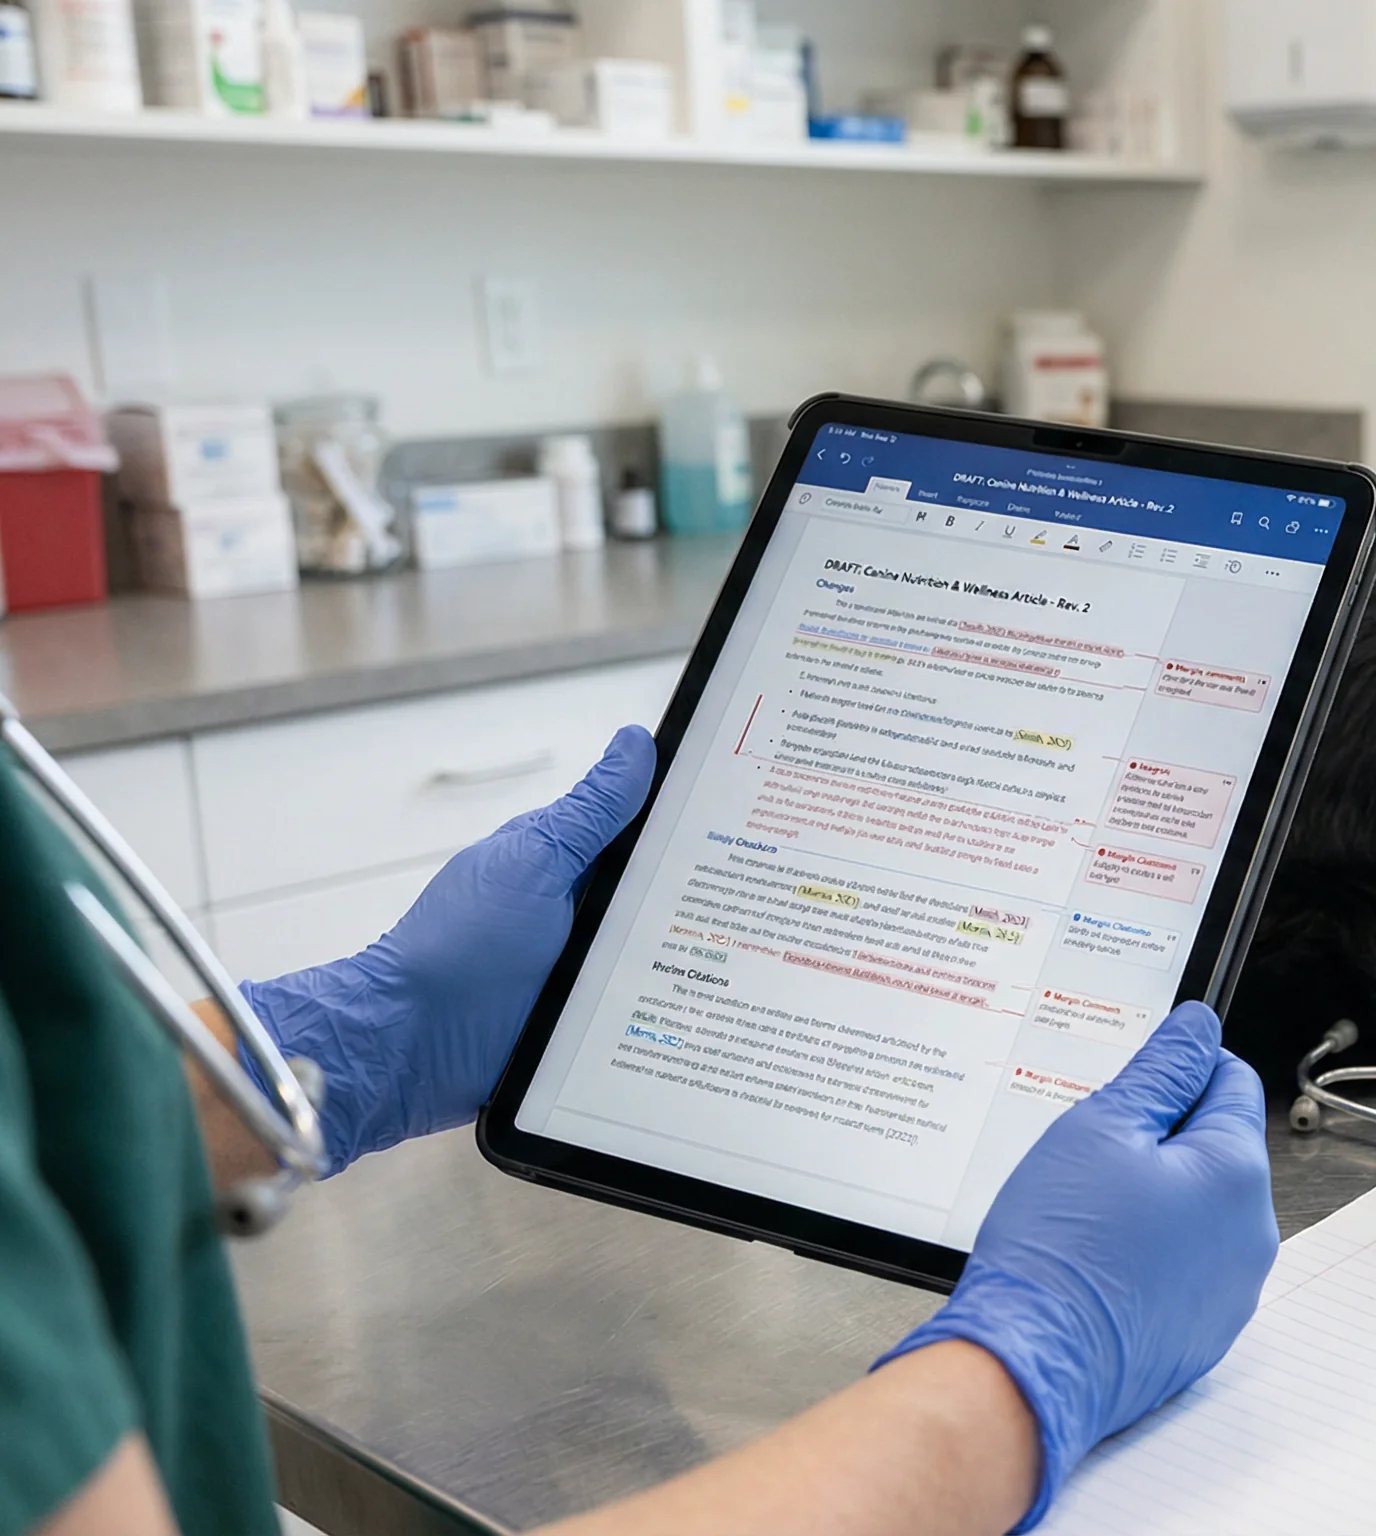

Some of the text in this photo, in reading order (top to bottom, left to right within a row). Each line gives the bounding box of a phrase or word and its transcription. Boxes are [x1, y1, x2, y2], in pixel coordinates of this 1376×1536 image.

[1165, 505, 1174, 513] 2
[825, 559, 862, 574] DRAFT:
[864, 566, 899, 580] Canine
[901, 572, 949, 589] Nutrition
[964, 583, 1009, 599] Wellness
[1011, 592, 1047, 605] Article
[1057, 598, 1079, 611] Rev.
[1082, 603, 1090, 612] 2
